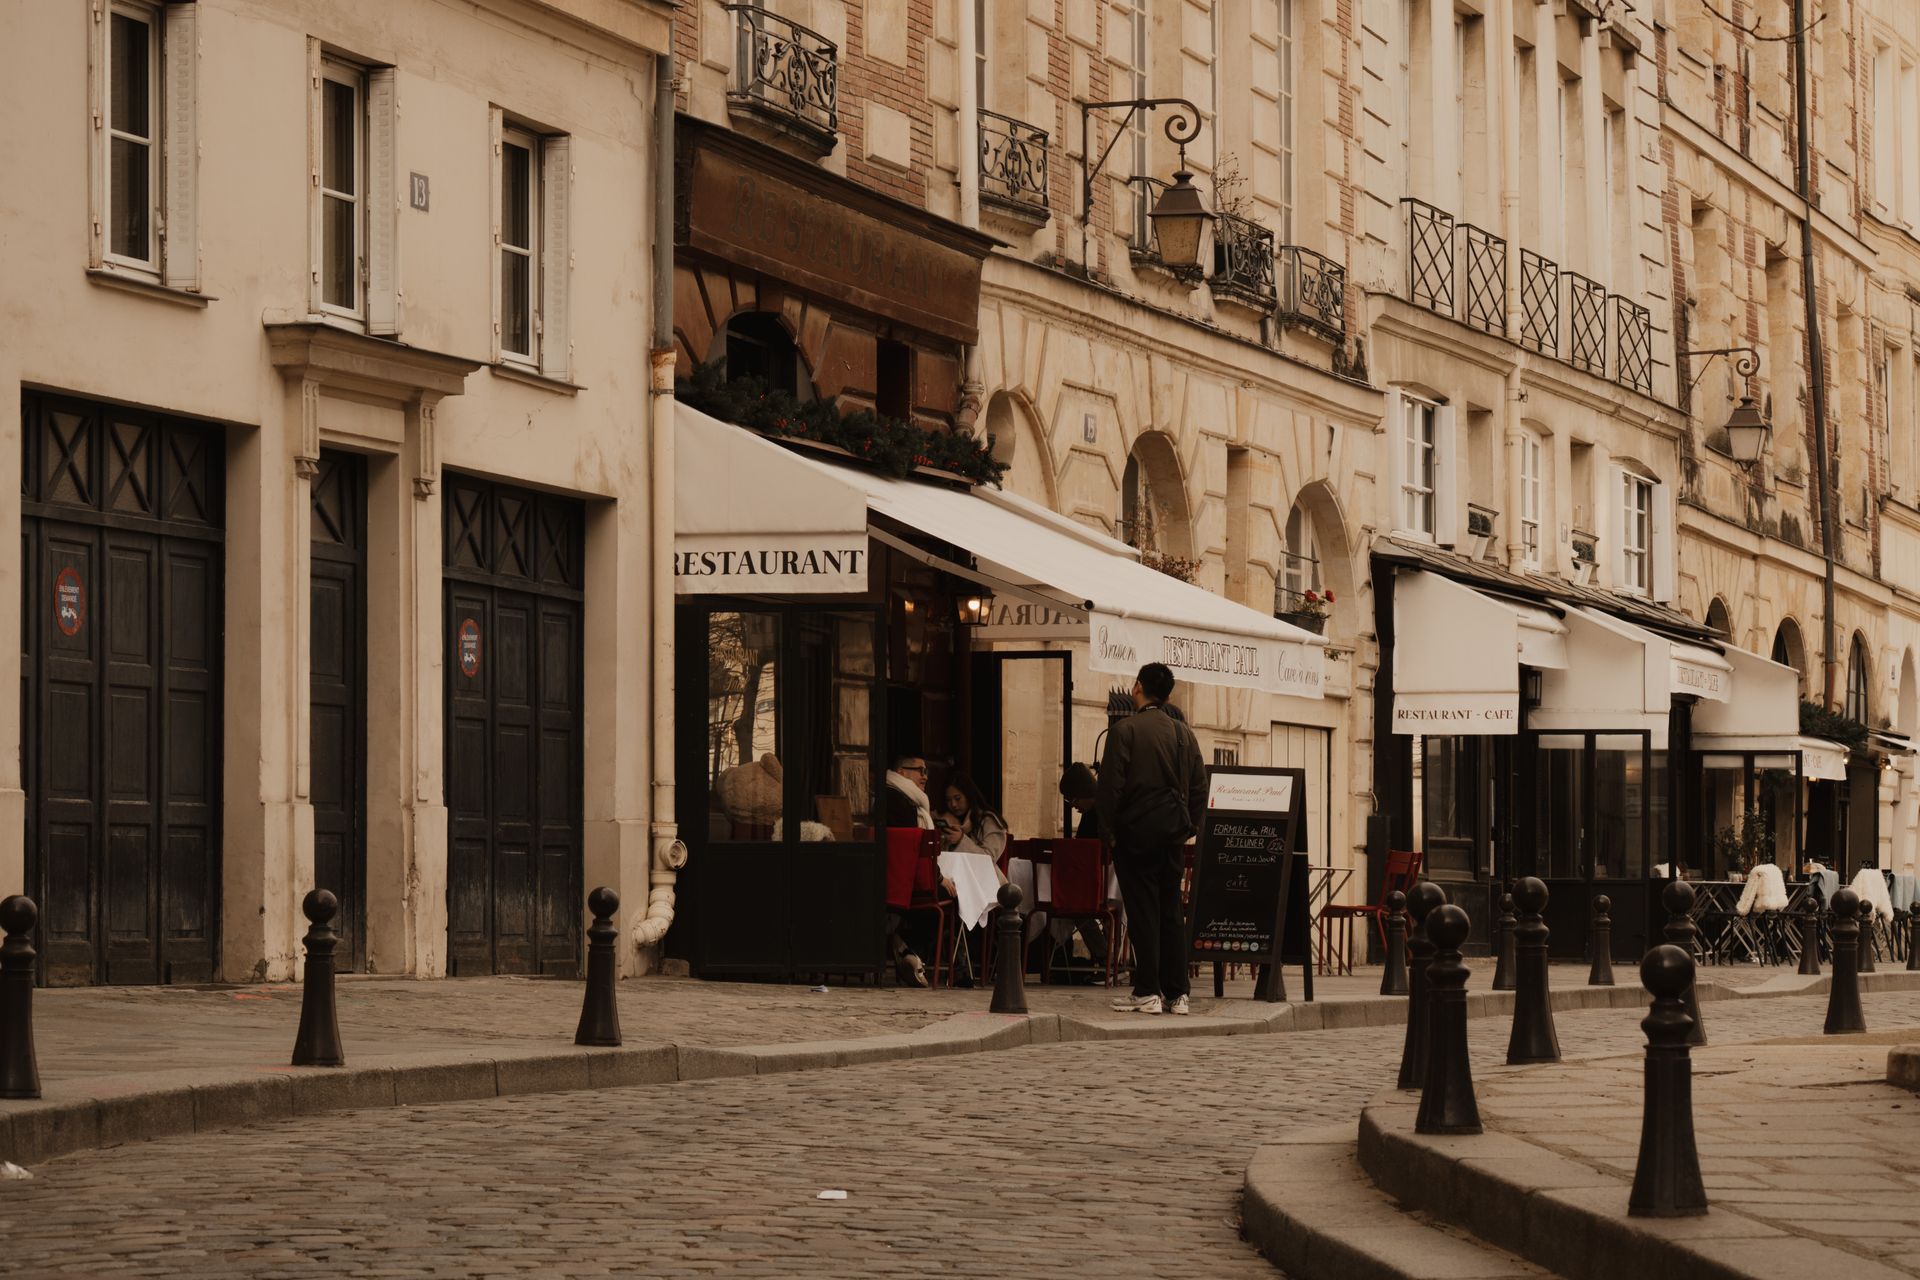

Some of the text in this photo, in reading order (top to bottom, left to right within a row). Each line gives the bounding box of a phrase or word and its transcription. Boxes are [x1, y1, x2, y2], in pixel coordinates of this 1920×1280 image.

[413, 176, 426, 207] 13
[730, 174, 945, 304] RESTAURANT
[1163, 636, 1259, 676] RESTAURANT PAUL
[1398, 709, 1473, 720] RESTAURANT
[1484, 709, 1514, 720] CAFE
[1216, 784, 1288, 797] Restaurant Paul
[1214, 824, 1248, 835] FORMULE
[1218, 853, 1244, 864] PLAT
